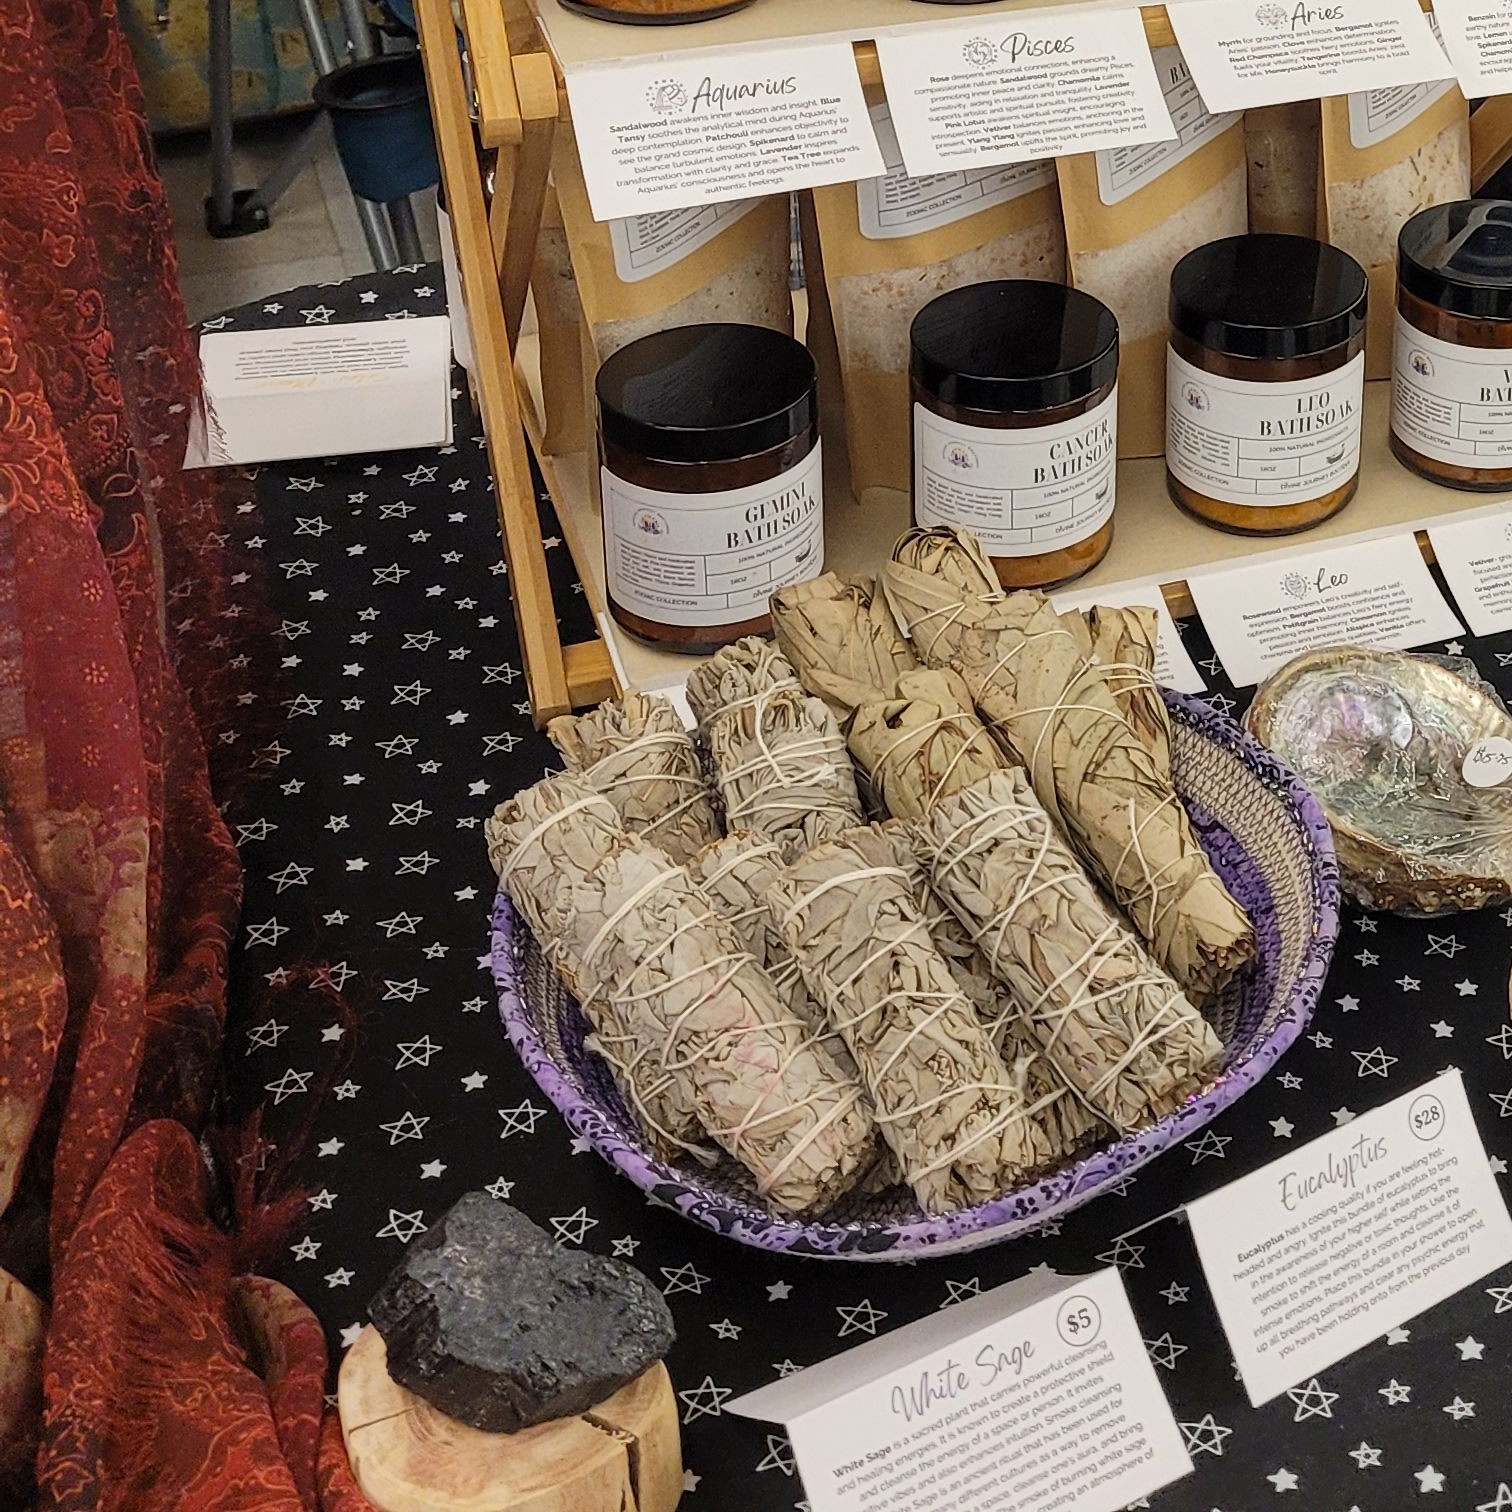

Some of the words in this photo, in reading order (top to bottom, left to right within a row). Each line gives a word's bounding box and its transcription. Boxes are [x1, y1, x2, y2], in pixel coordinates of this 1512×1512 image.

[1291, 1, 1344, 30] Aries
[1000, 32, 1075, 63] Pisces
[691, 76, 797, 113] Aquarius
[610, 119, 668, 133] Sandalwood
[749, 134, 795, 147] Spikenard
[760, 144, 802, 155] Lavender
[1297, 391, 1330, 414] LEO
[1260, 416, 1312, 436] BATH
[1315, 400, 1353, 430] SOAK
[1050, 418, 1108, 460] CANCER
[1034, 459, 1082, 484] BATH
[1085, 434, 1113, 467] SOAK
[745, 482, 805, 524] GEMINI
[726, 517, 778, 549] BATH
[782, 496, 815, 531] SOAK
[1312, 568, 1349, 594] Leo
[1413, 1105, 1441, 1130] $28
[1277, 1133, 1389, 1211] Eucalyptus
[1386, 1173, 1429, 1199] eucalyptus
[1237, 1233, 1285, 1262] Eucalyptus
[1065, 1307, 1092, 1335] $5
[890, 1357, 970, 1423] White
[975, 1339, 1037, 1388] Sage
[832, 1459, 865, 1478] White
[865, 1446, 892, 1463] Sage
[1022, 1360, 1064, 1388] powerful
